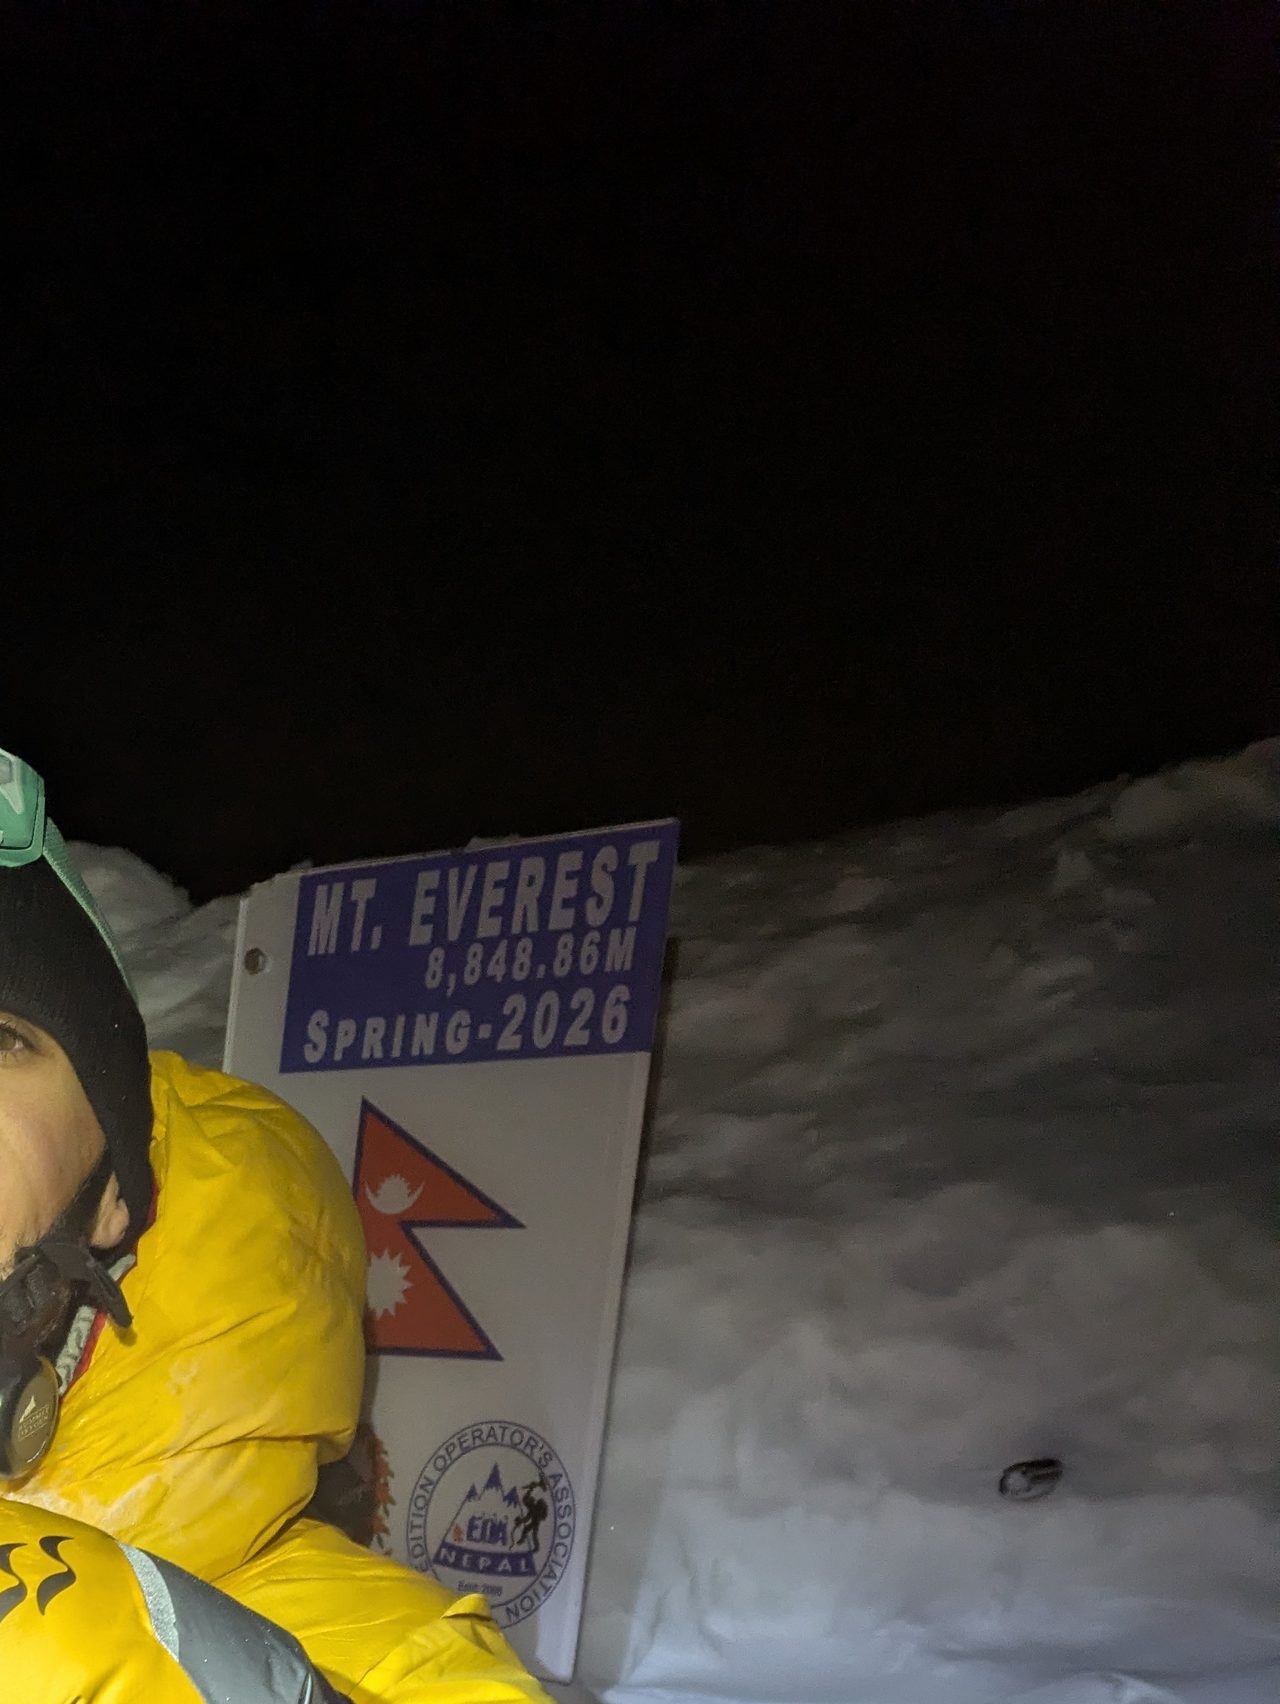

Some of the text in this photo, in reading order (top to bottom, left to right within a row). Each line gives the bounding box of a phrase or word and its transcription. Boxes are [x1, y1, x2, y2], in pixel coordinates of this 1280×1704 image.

[307, 840, 661, 957] MT. EVEREST
[425, 926, 638, 996] 8,848.86M
[433, 1425, 554, 1473] OPERATOR'S
[506, 1472, 572, 1622] ASSOCIATION
[439, 1548, 529, 1573] NEPAL
